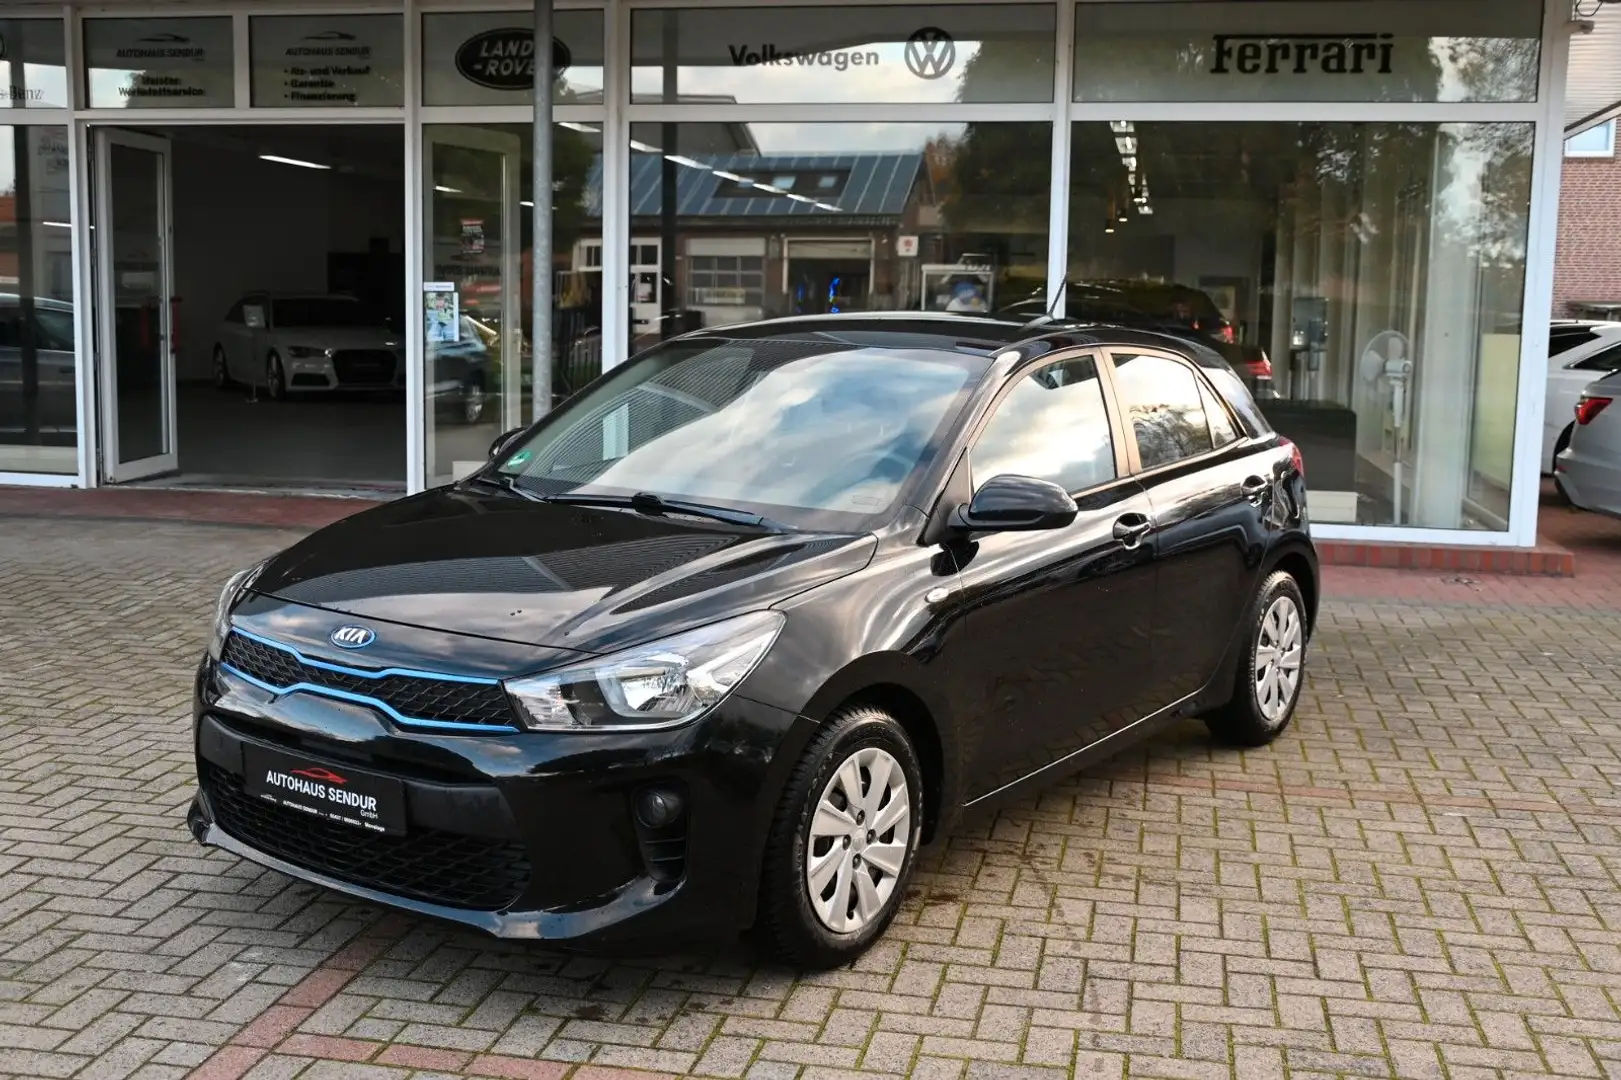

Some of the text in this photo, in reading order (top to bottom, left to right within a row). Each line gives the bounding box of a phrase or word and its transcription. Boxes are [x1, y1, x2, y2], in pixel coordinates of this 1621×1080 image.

[480, 40, 535, 57] LAND
[729, 44, 879, 71] Volkswagen
[1210, 33, 1394, 74] Ferrari
[334, 627, 368, 644] KIA
[266, 770, 377, 811] AUTOHAUS SENDUR
[360, 809, 379, 819] GmbH
